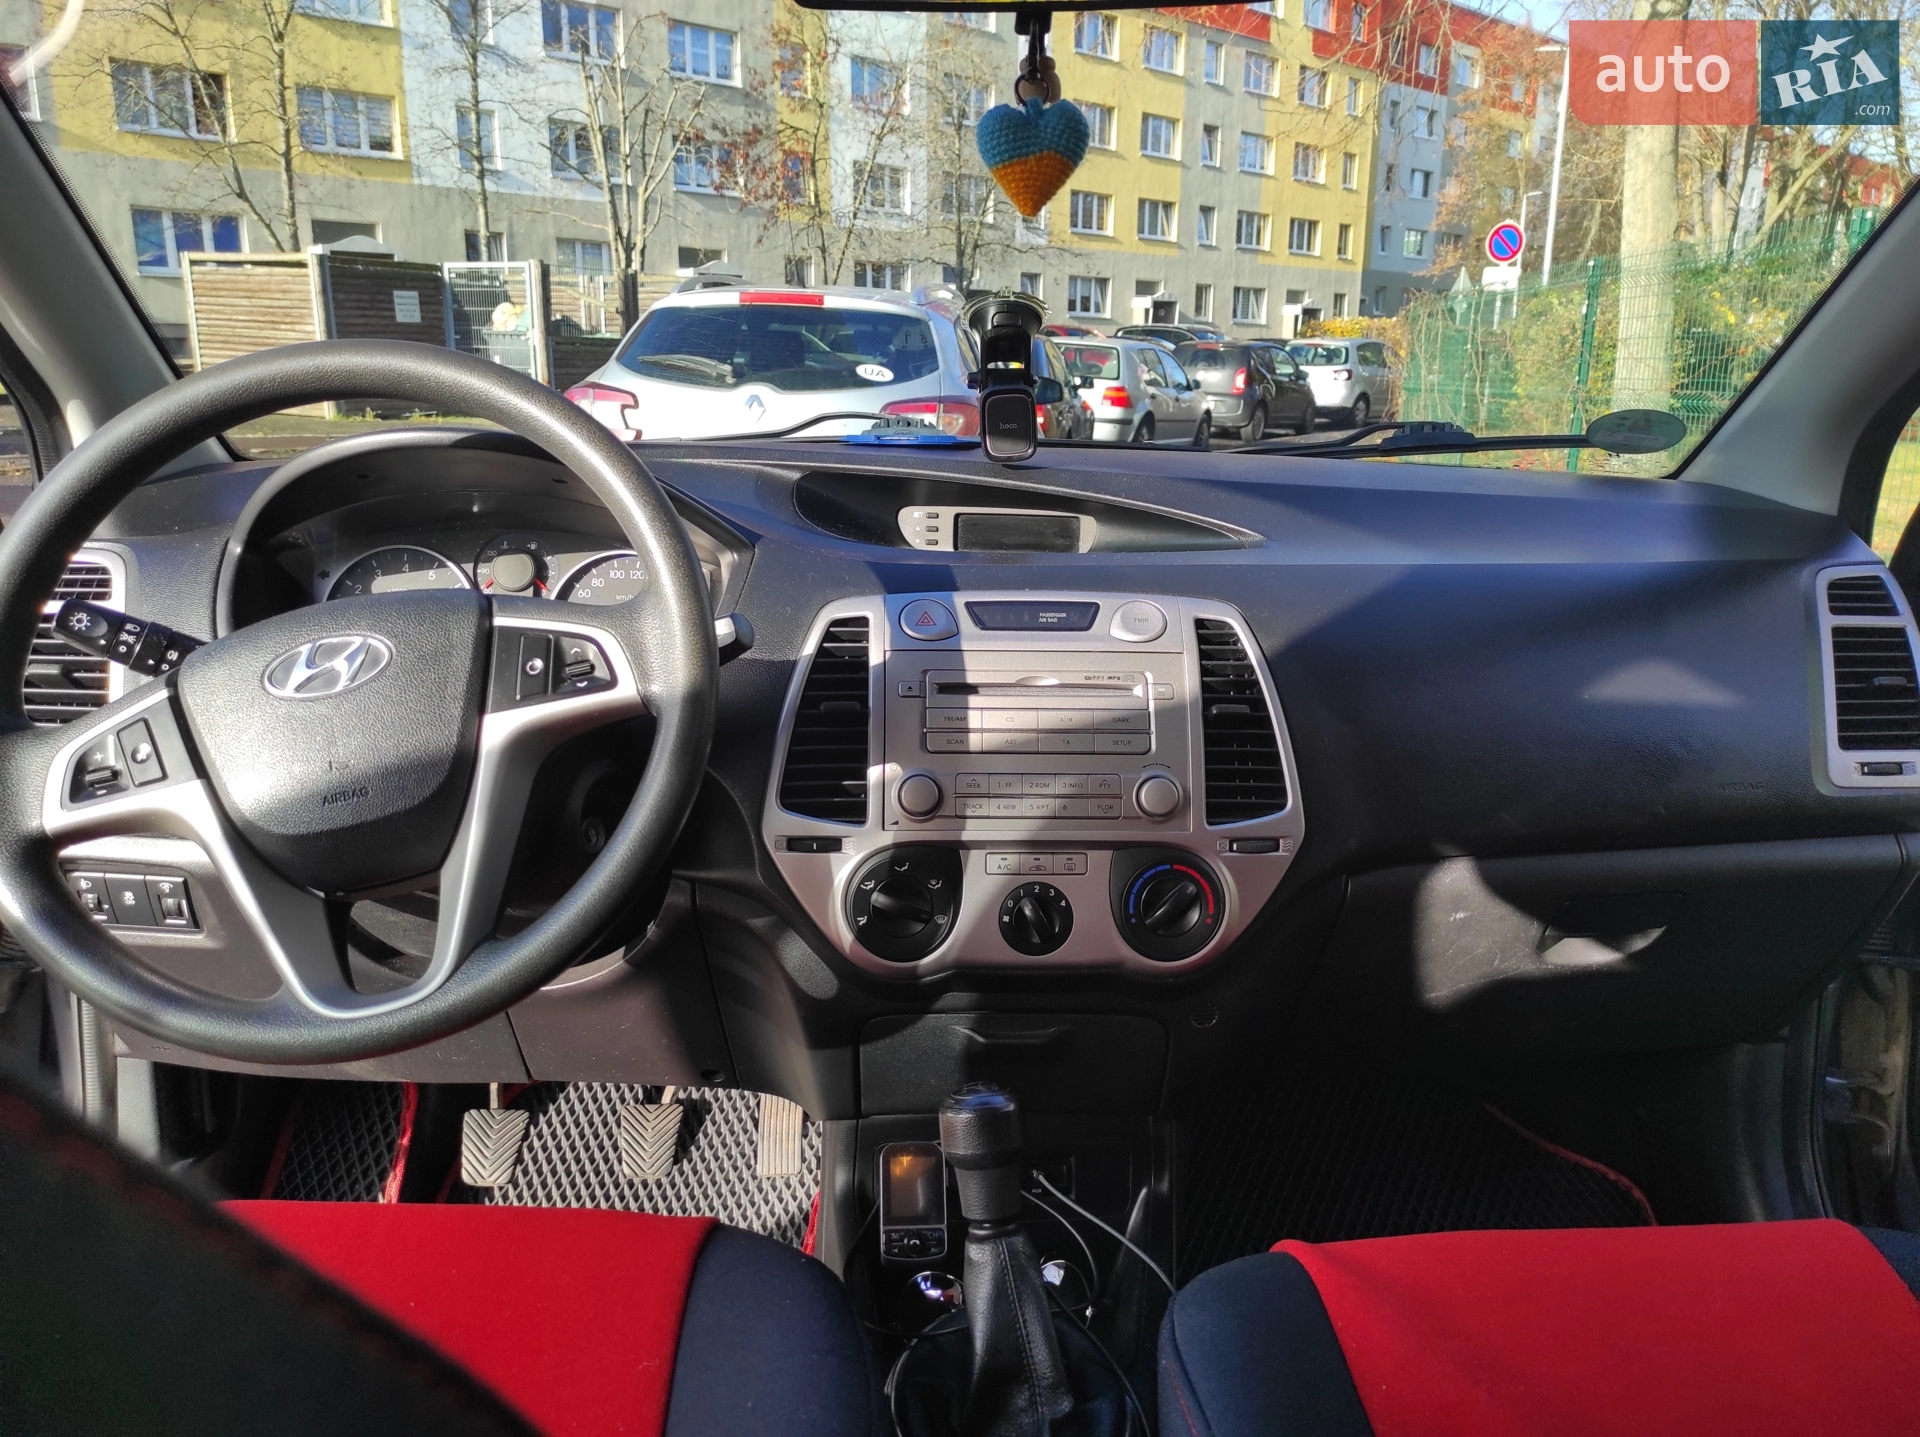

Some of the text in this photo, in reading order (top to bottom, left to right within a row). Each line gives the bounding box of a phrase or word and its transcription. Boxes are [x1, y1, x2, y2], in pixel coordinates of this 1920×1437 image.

[864, 367, 886, 378] UA
[402, 564, 410, 572] 4
[374, 570, 382, 579] 3
[428, 570, 436, 580] 5
[609, 570, 625, 580] 100
[629, 570, 644, 580] 120
[591, 578, 604, 588] 80
[354, 584, 362, 594] 2
[578, 589, 591, 598] 60
[322, 786, 372, 806] AIRBAG
[1020, 889, 1024, 897] 1
[1049, 888, 1055, 896] 3
[1008, 900, 1014, 908] 0
